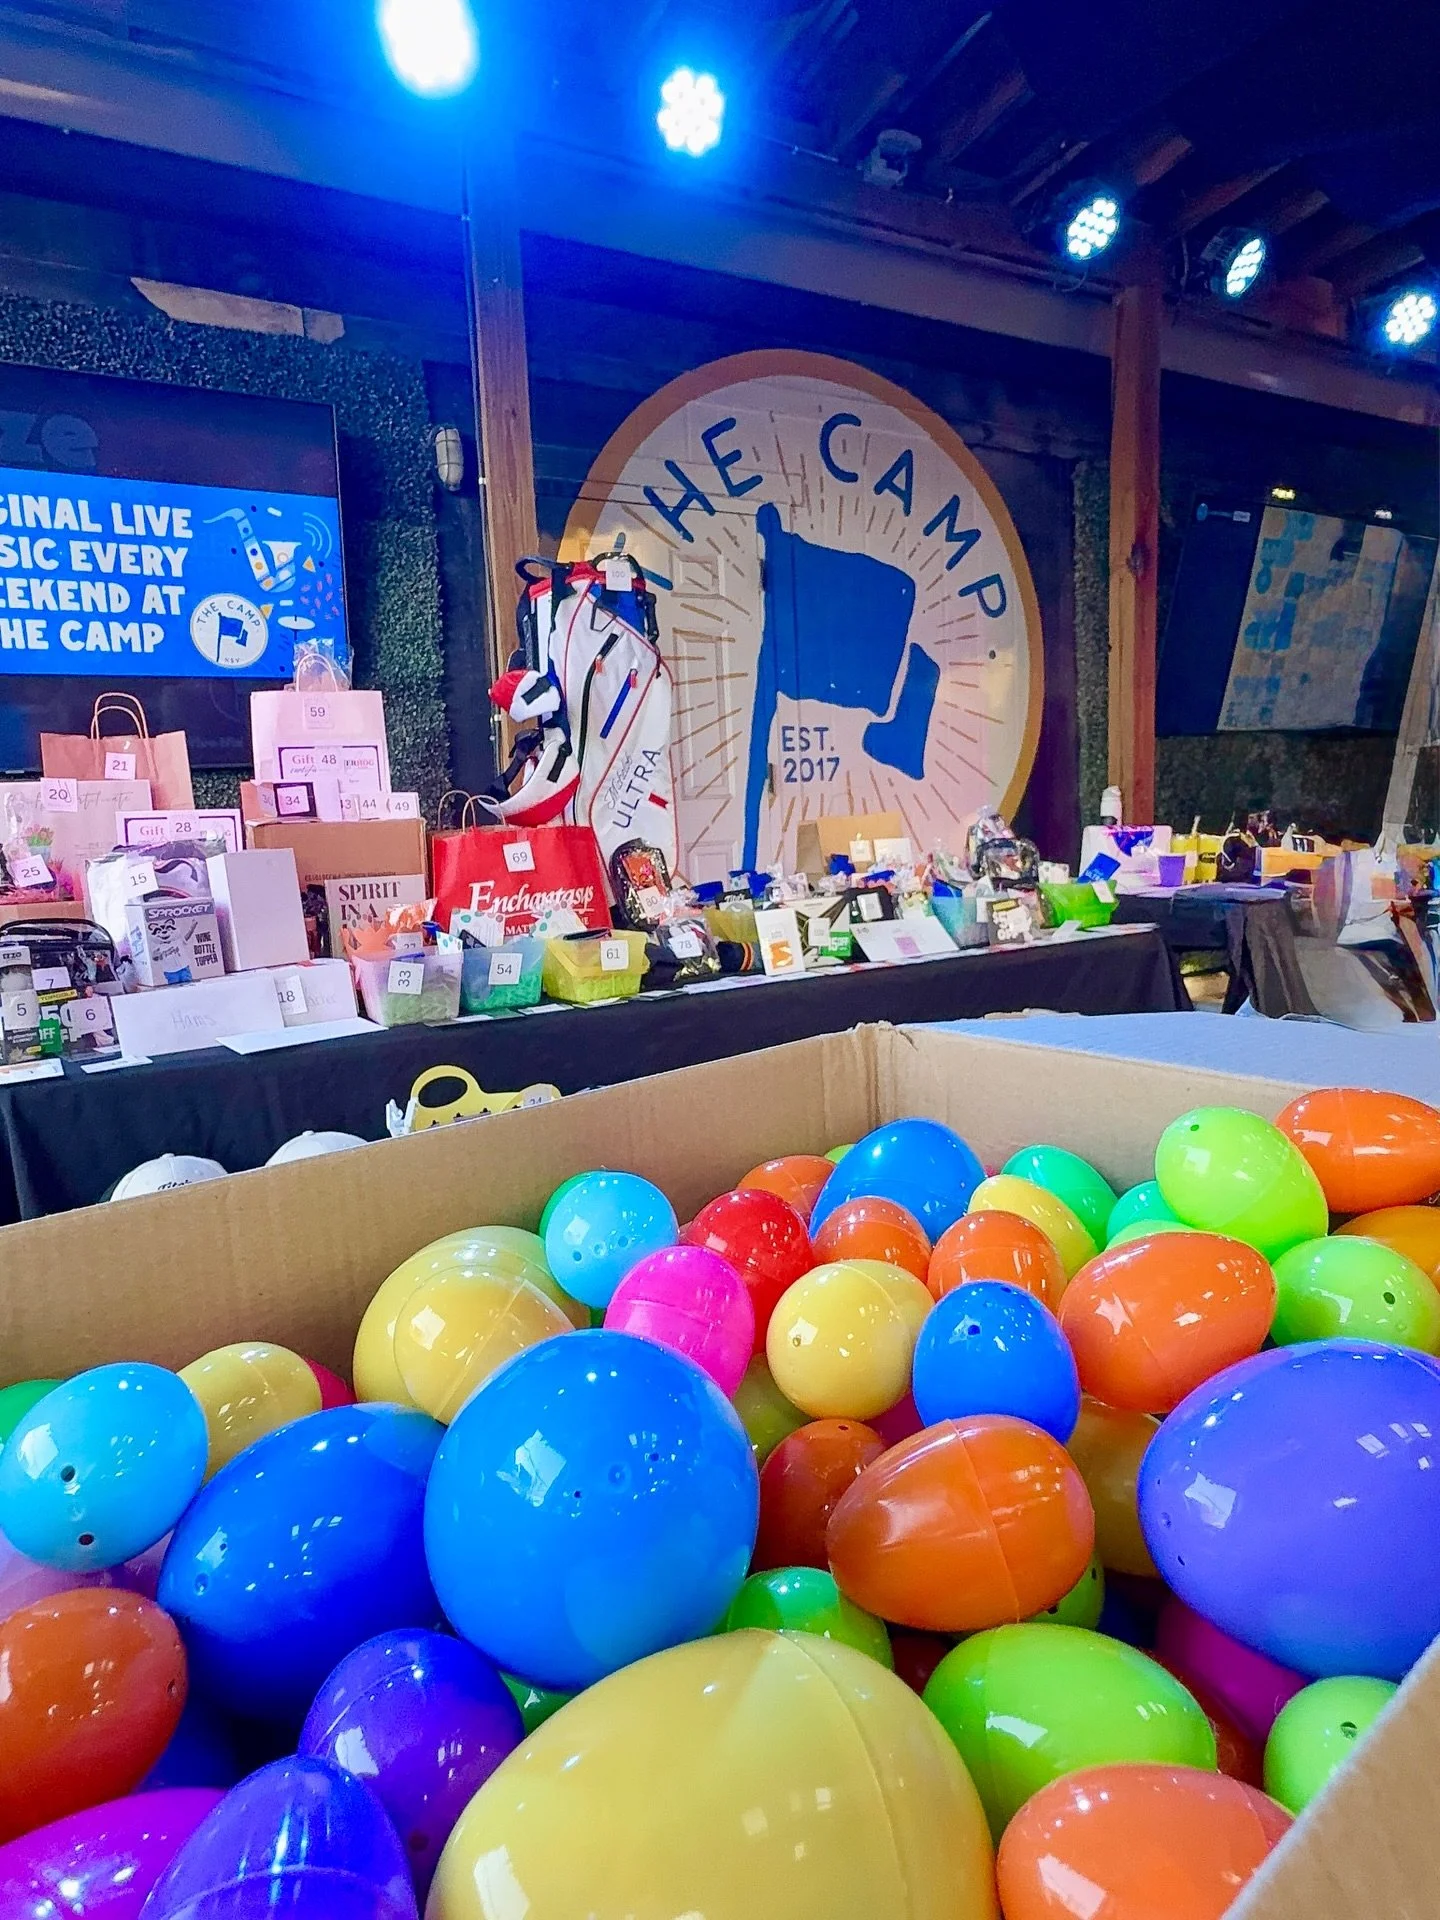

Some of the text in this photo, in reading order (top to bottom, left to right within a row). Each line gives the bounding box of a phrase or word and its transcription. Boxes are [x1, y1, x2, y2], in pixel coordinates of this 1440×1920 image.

[111, 502, 193, 539] LIVE
[818, 412, 1007, 618] CAMP
[0, 534, 188, 577] SIC EVERY
[0, 577, 186, 615] EKEND AT
[196, 600, 260, 627] THE CAMP
[0, 618, 165, 653] HE CAMP
[309, 706, 326, 717] 59
[781, 726, 835, 752] EST.
[112, 760, 129, 771] 21
[321, 754, 337, 765] 48
[783, 757, 840, 783] 2017
[48, 788, 68, 799] 20
[612, 750, 661, 828] ULTRA
[285, 795, 300, 805] 34
[362, 798, 376, 809] 44
[394, 801, 410, 811] 49
[139, 823, 164, 837] Gift
[175, 822, 192, 833] 28
[512, 851, 528, 863] 69
[21, 867, 41, 878] 25
[130, 872, 147, 886] 15
[338, 881, 401, 902] SPIRIT
[148, 904, 211, 919] SPROCKET
[193, 943, 216, 955] BOTTLE
[678, 940, 693, 950] 78
[606, 948, 621, 959] 61
[496, 964, 512, 975] 54
[398, 970, 411, 987] 33
[277, 990, 295, 1003] 18
[16, 1003, 27, 1016] 5
[85, 1008, 96, 1020] 6
